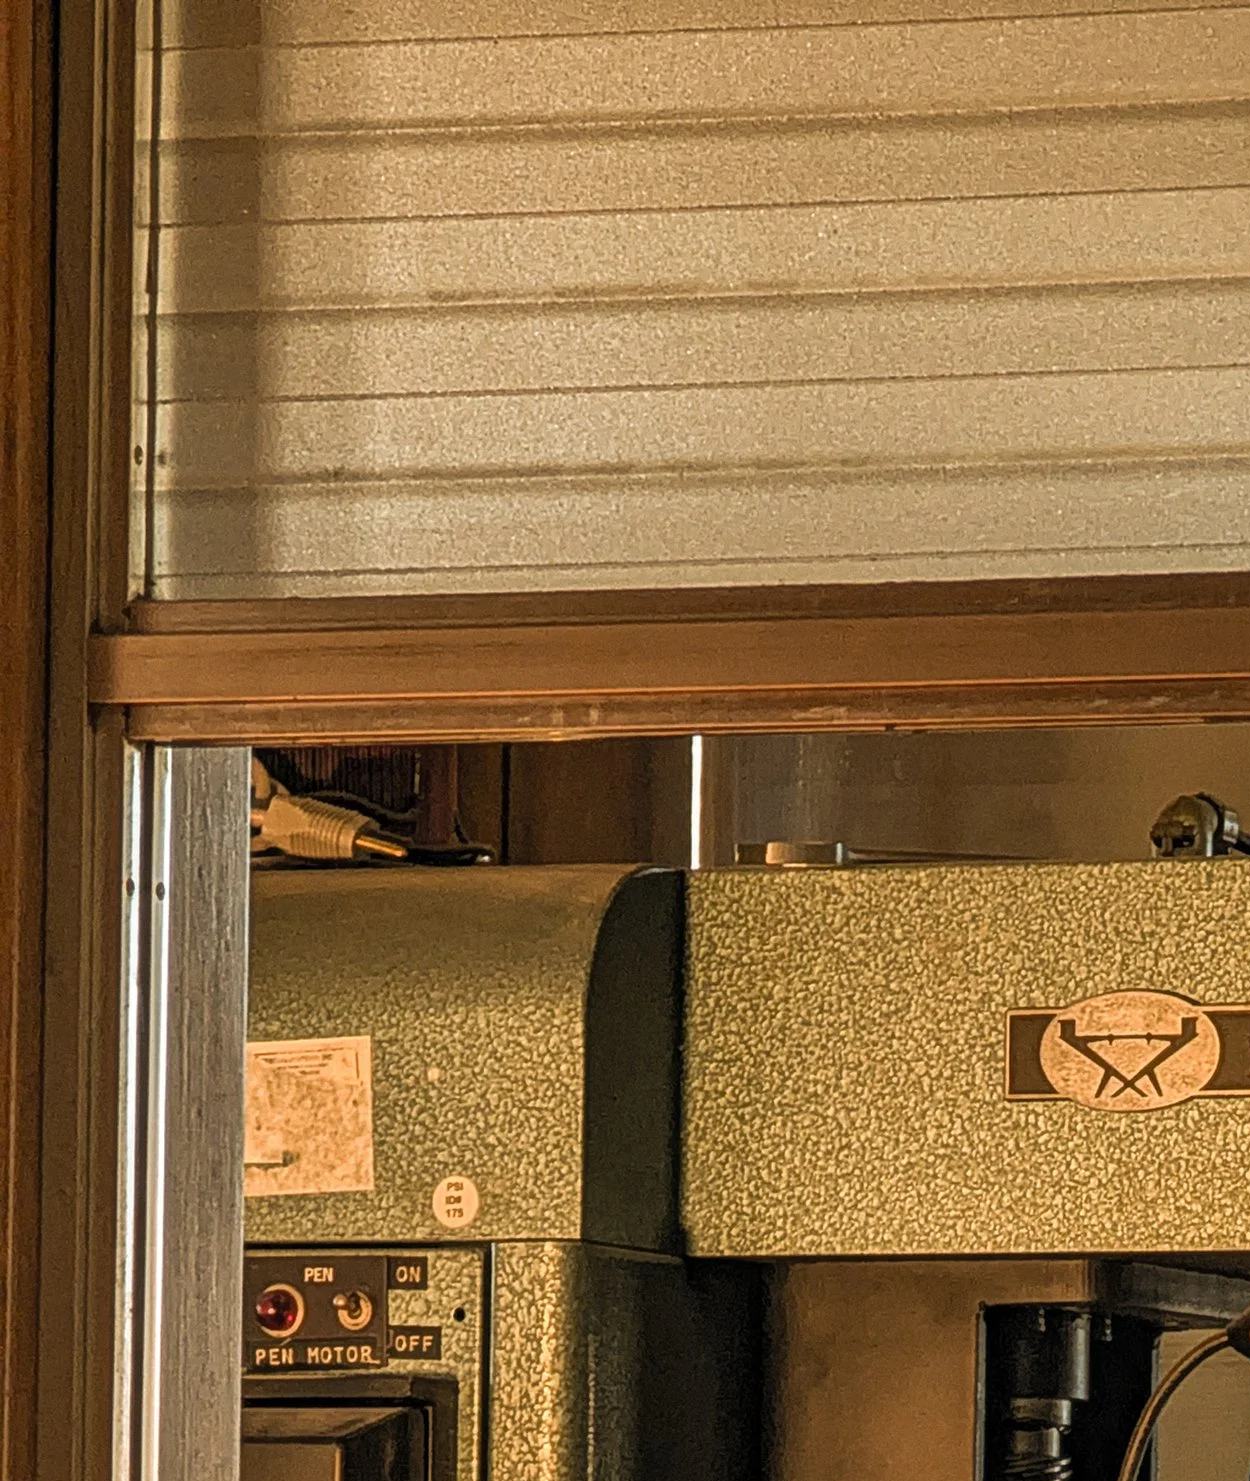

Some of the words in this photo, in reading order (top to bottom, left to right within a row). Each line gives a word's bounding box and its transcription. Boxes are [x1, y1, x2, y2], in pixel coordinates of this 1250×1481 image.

[447, 1181, 464, 1191] PSI
[446, 1208, 464, 1218] 175
[304, 1267, 334, 1282] PEN
[395, 1265, 422, 1282] ON
[395, 1335, 434, 1353] OFF
[255, 1349, 294, 1365] PEN
[307, 1345, 373, 1364] MOTOR
